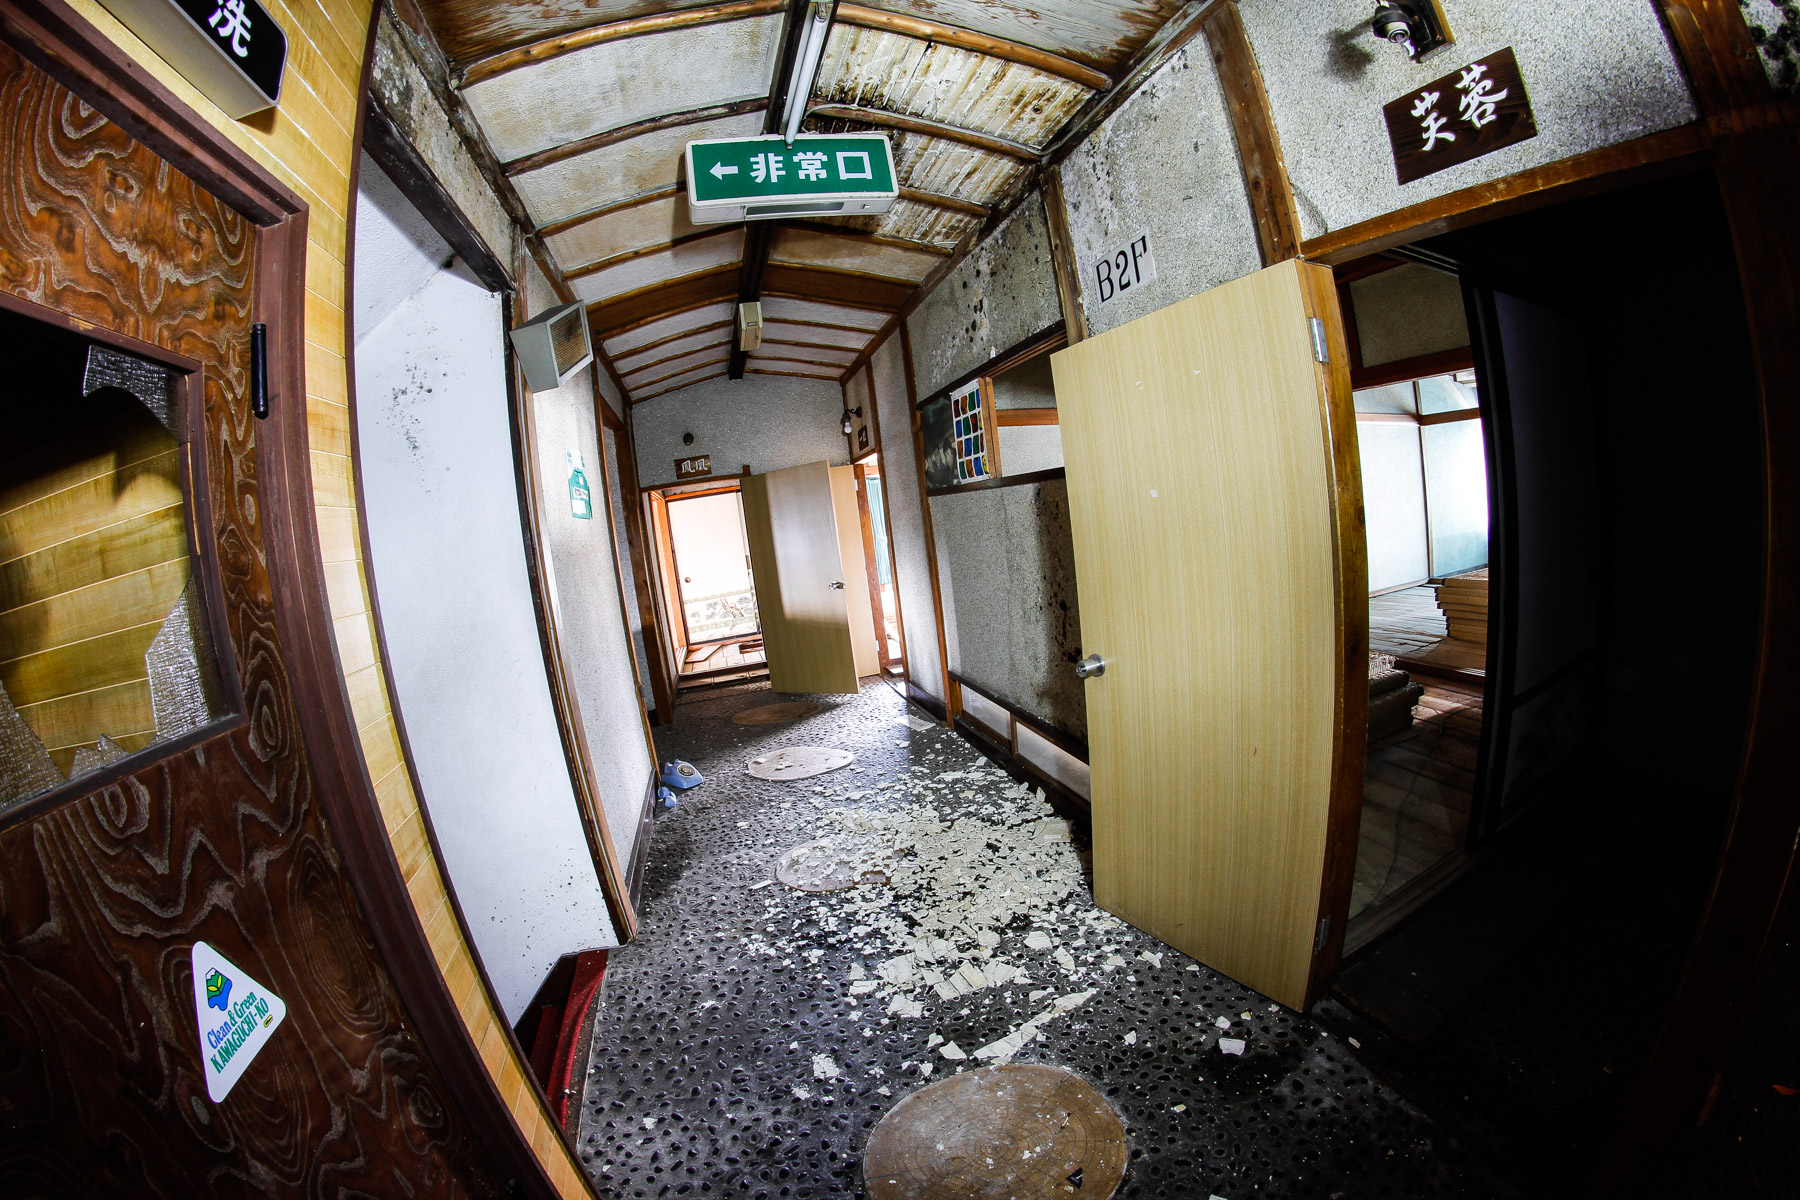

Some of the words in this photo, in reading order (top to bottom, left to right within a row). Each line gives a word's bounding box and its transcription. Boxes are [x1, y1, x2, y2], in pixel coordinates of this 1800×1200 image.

[208, 0, 252, 57] 洗
[1410, 63, 1509, 151] 芙蓉
[749, 151, 873, 184] 非常口
[1096, 234, 1148, 303] B2F
[207, 1020, 233, 1050] Clean
[227, 1009, 239, 1028] &
[233, 991, 258, 1020] Green
[210, 997, 270, 1074] KAWAGUCHI-KO
